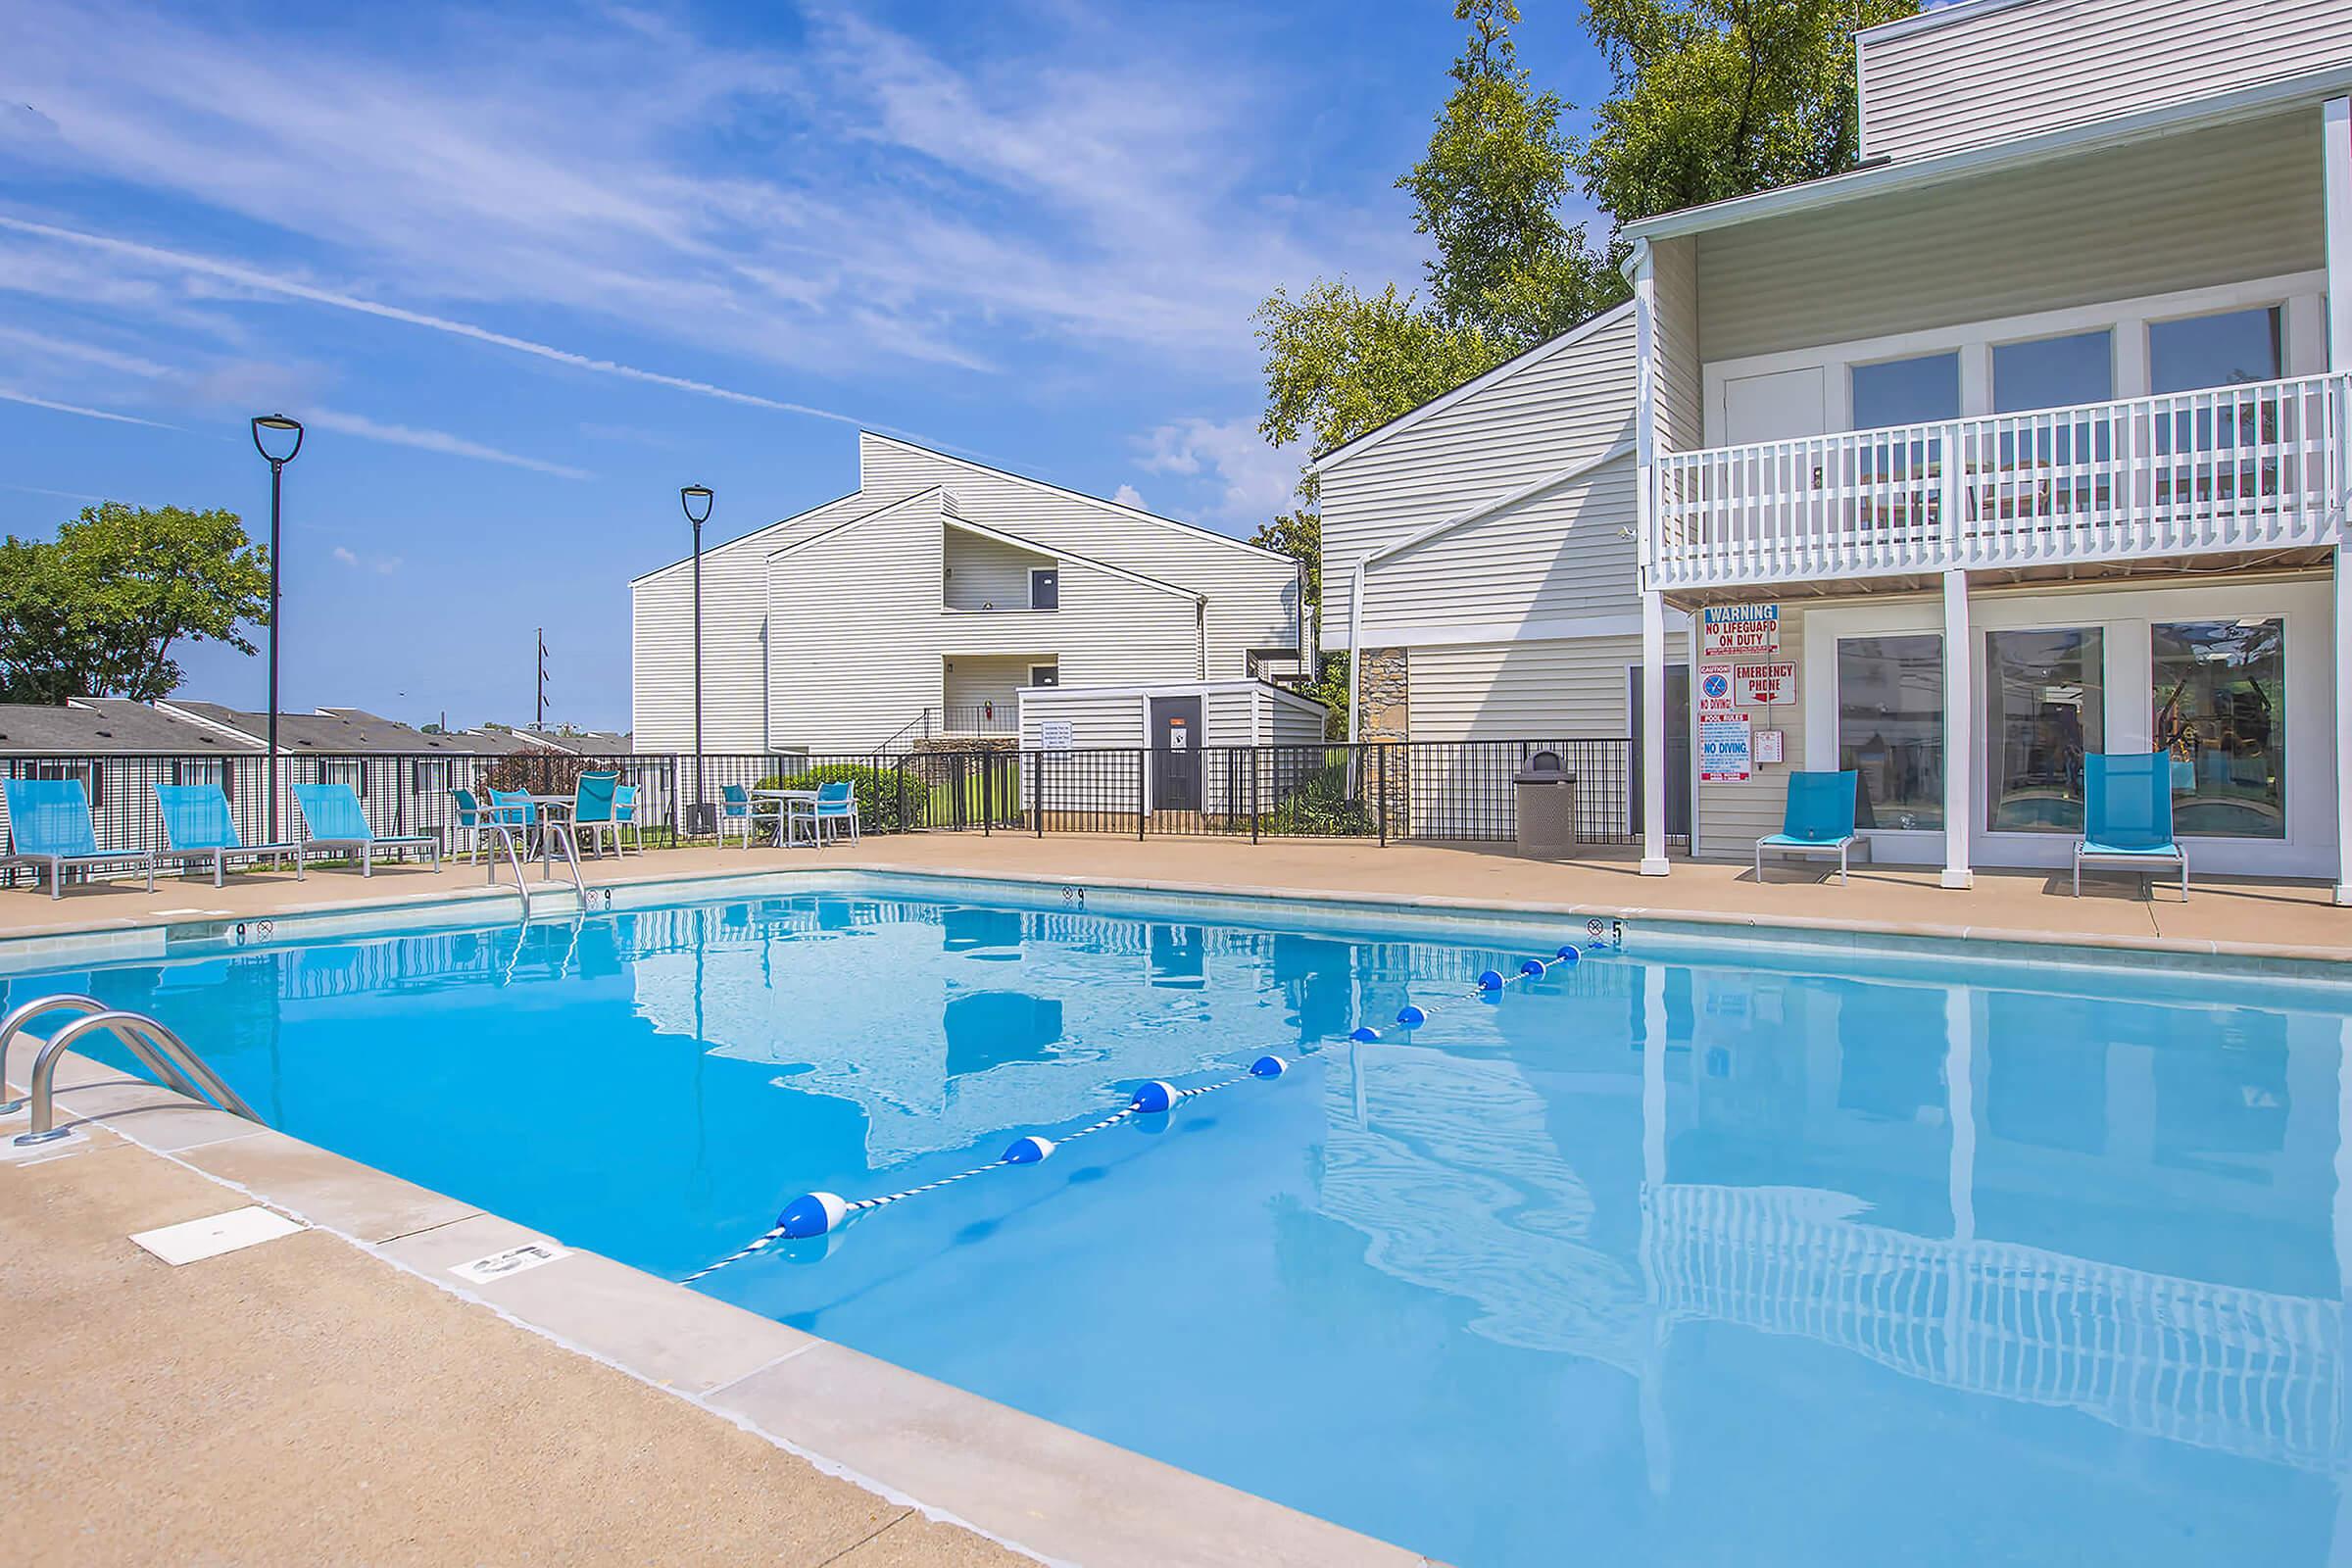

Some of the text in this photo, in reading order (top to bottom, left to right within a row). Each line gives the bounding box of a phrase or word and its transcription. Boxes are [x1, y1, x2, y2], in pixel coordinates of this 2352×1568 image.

[1710, 605, 1773, 622] WARNING
[1705, 621, 1777, 635] NO LIFEGUARD
[1720, 634, 1763, 646] ON DUTY
[1737, 665, 1792, 678] EMERGENCY
[1748, 679, 1781, 691] PHONE
[1700, 699, 1708, 710] NO
[1704, 743, 1716, 753] NO
[1612, 921, 1622, 938] 5
